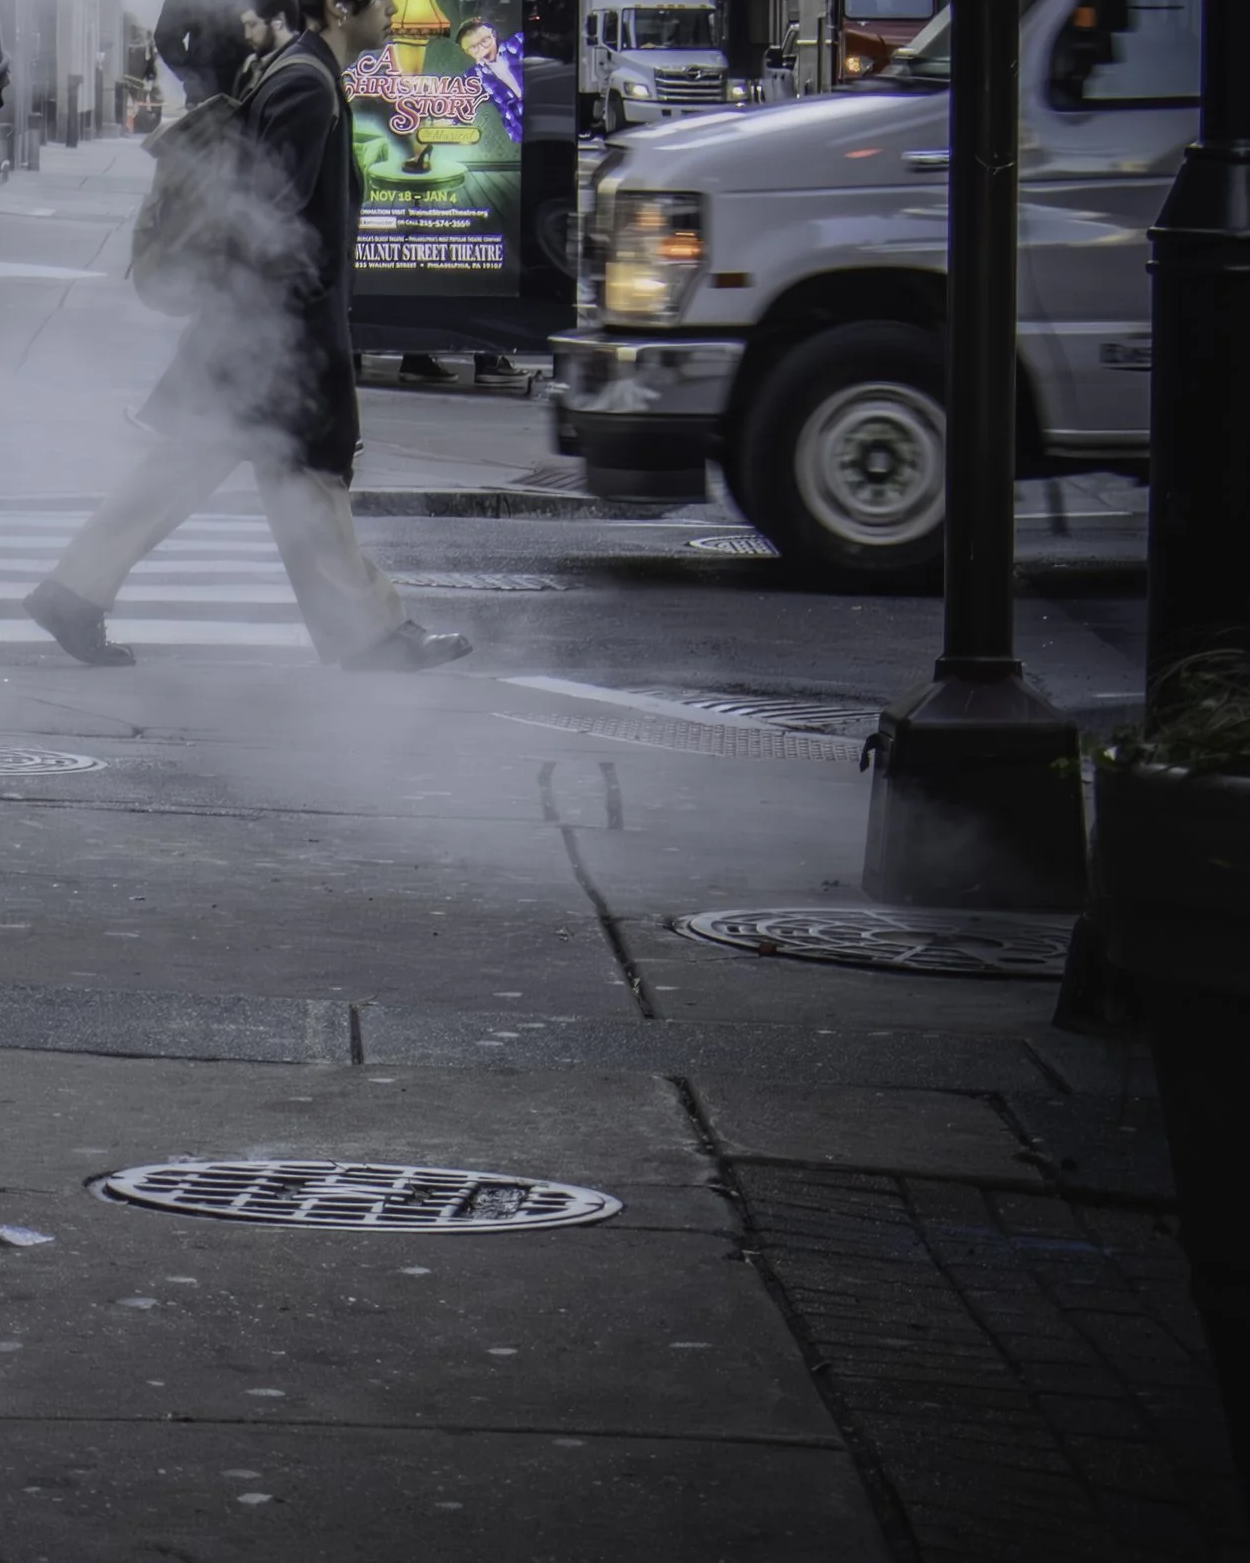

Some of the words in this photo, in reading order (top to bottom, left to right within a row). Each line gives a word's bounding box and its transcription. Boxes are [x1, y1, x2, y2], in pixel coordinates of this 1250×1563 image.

[357, 43, 402, 76] A
[342, 71, 483, 103] CHRISTMAS
[389, 94, 489, 135] STORY
[370, 191, 396, 202] NOV
[398, 191, 411, 202] 18
[424, 191, 448, 202] JAN
[449, 192, 457, 203] 4
[355, 243, 401, 261] WALNUT
[402, 243, 448, 261] STREET
[450, 243, 503, 261] THEATRE
